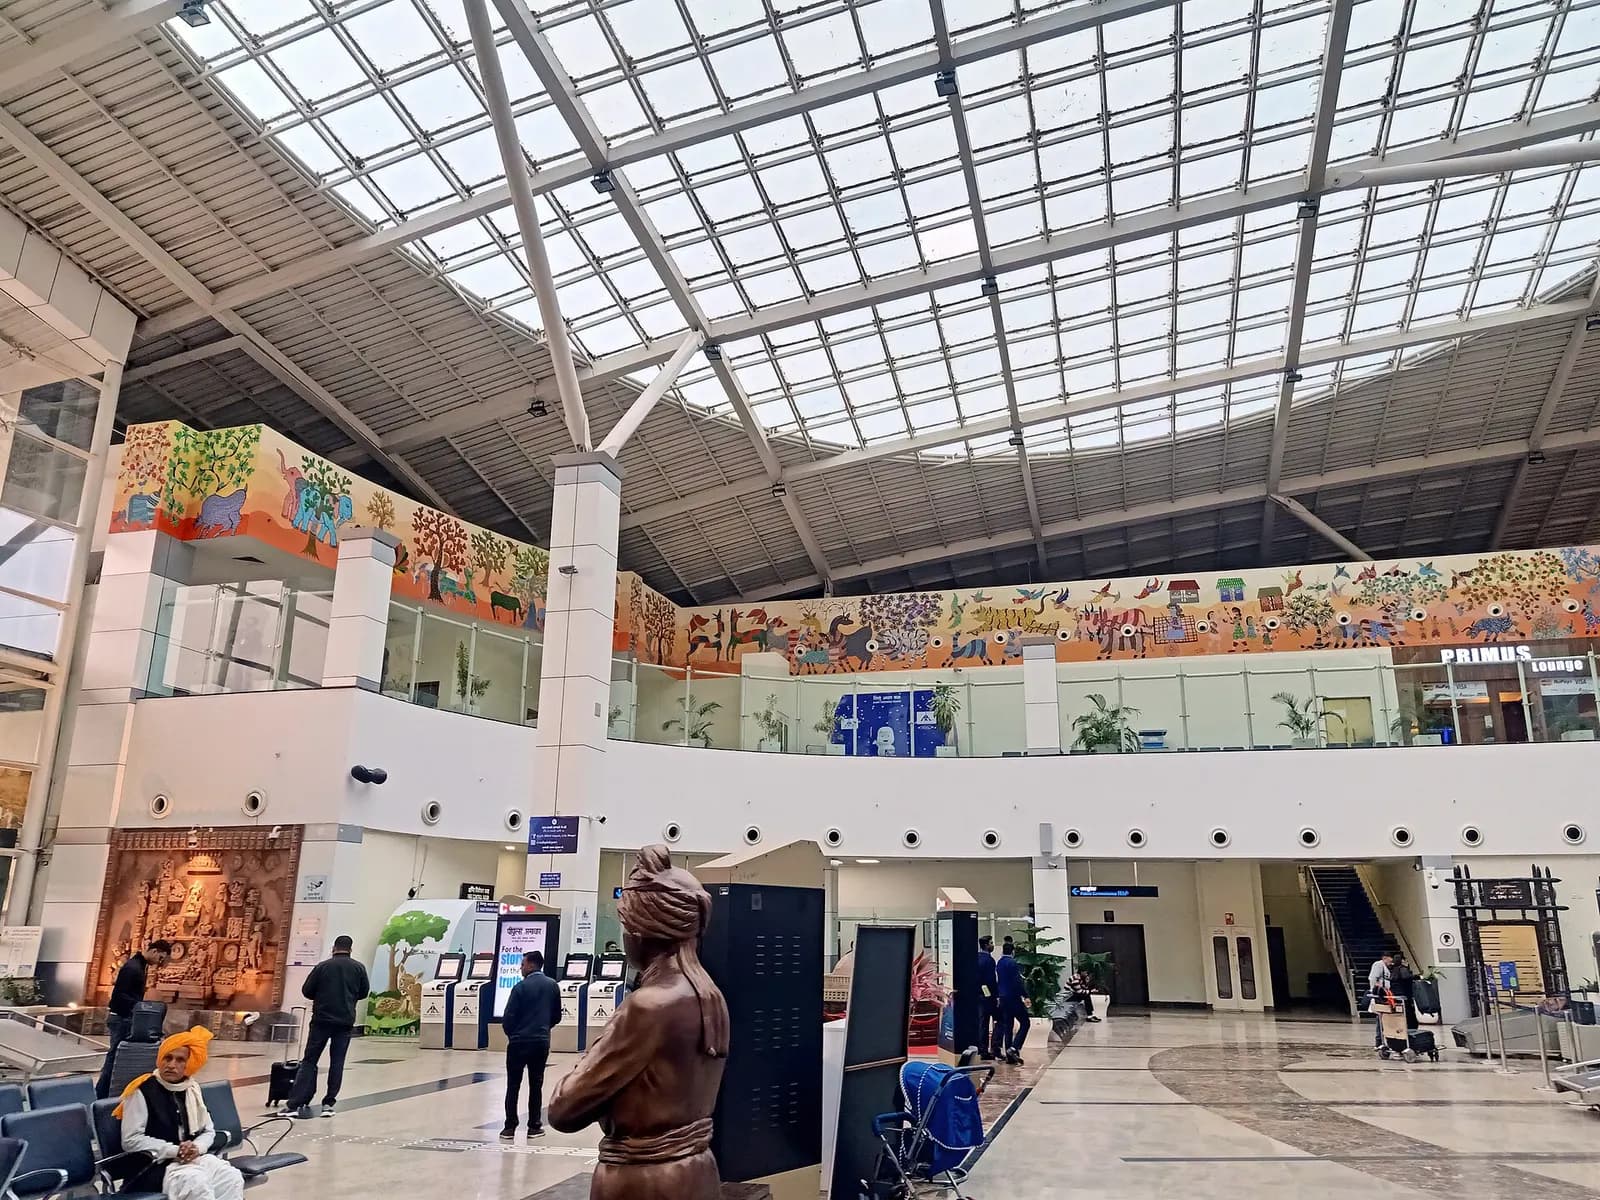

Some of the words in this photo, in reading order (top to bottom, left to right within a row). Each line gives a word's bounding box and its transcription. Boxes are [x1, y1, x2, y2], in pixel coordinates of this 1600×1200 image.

[1440, 645, 1532, 664] PRIMUS
[1531, 659, 1584, 673] Lounge
[512, 945, 523, 953] the
